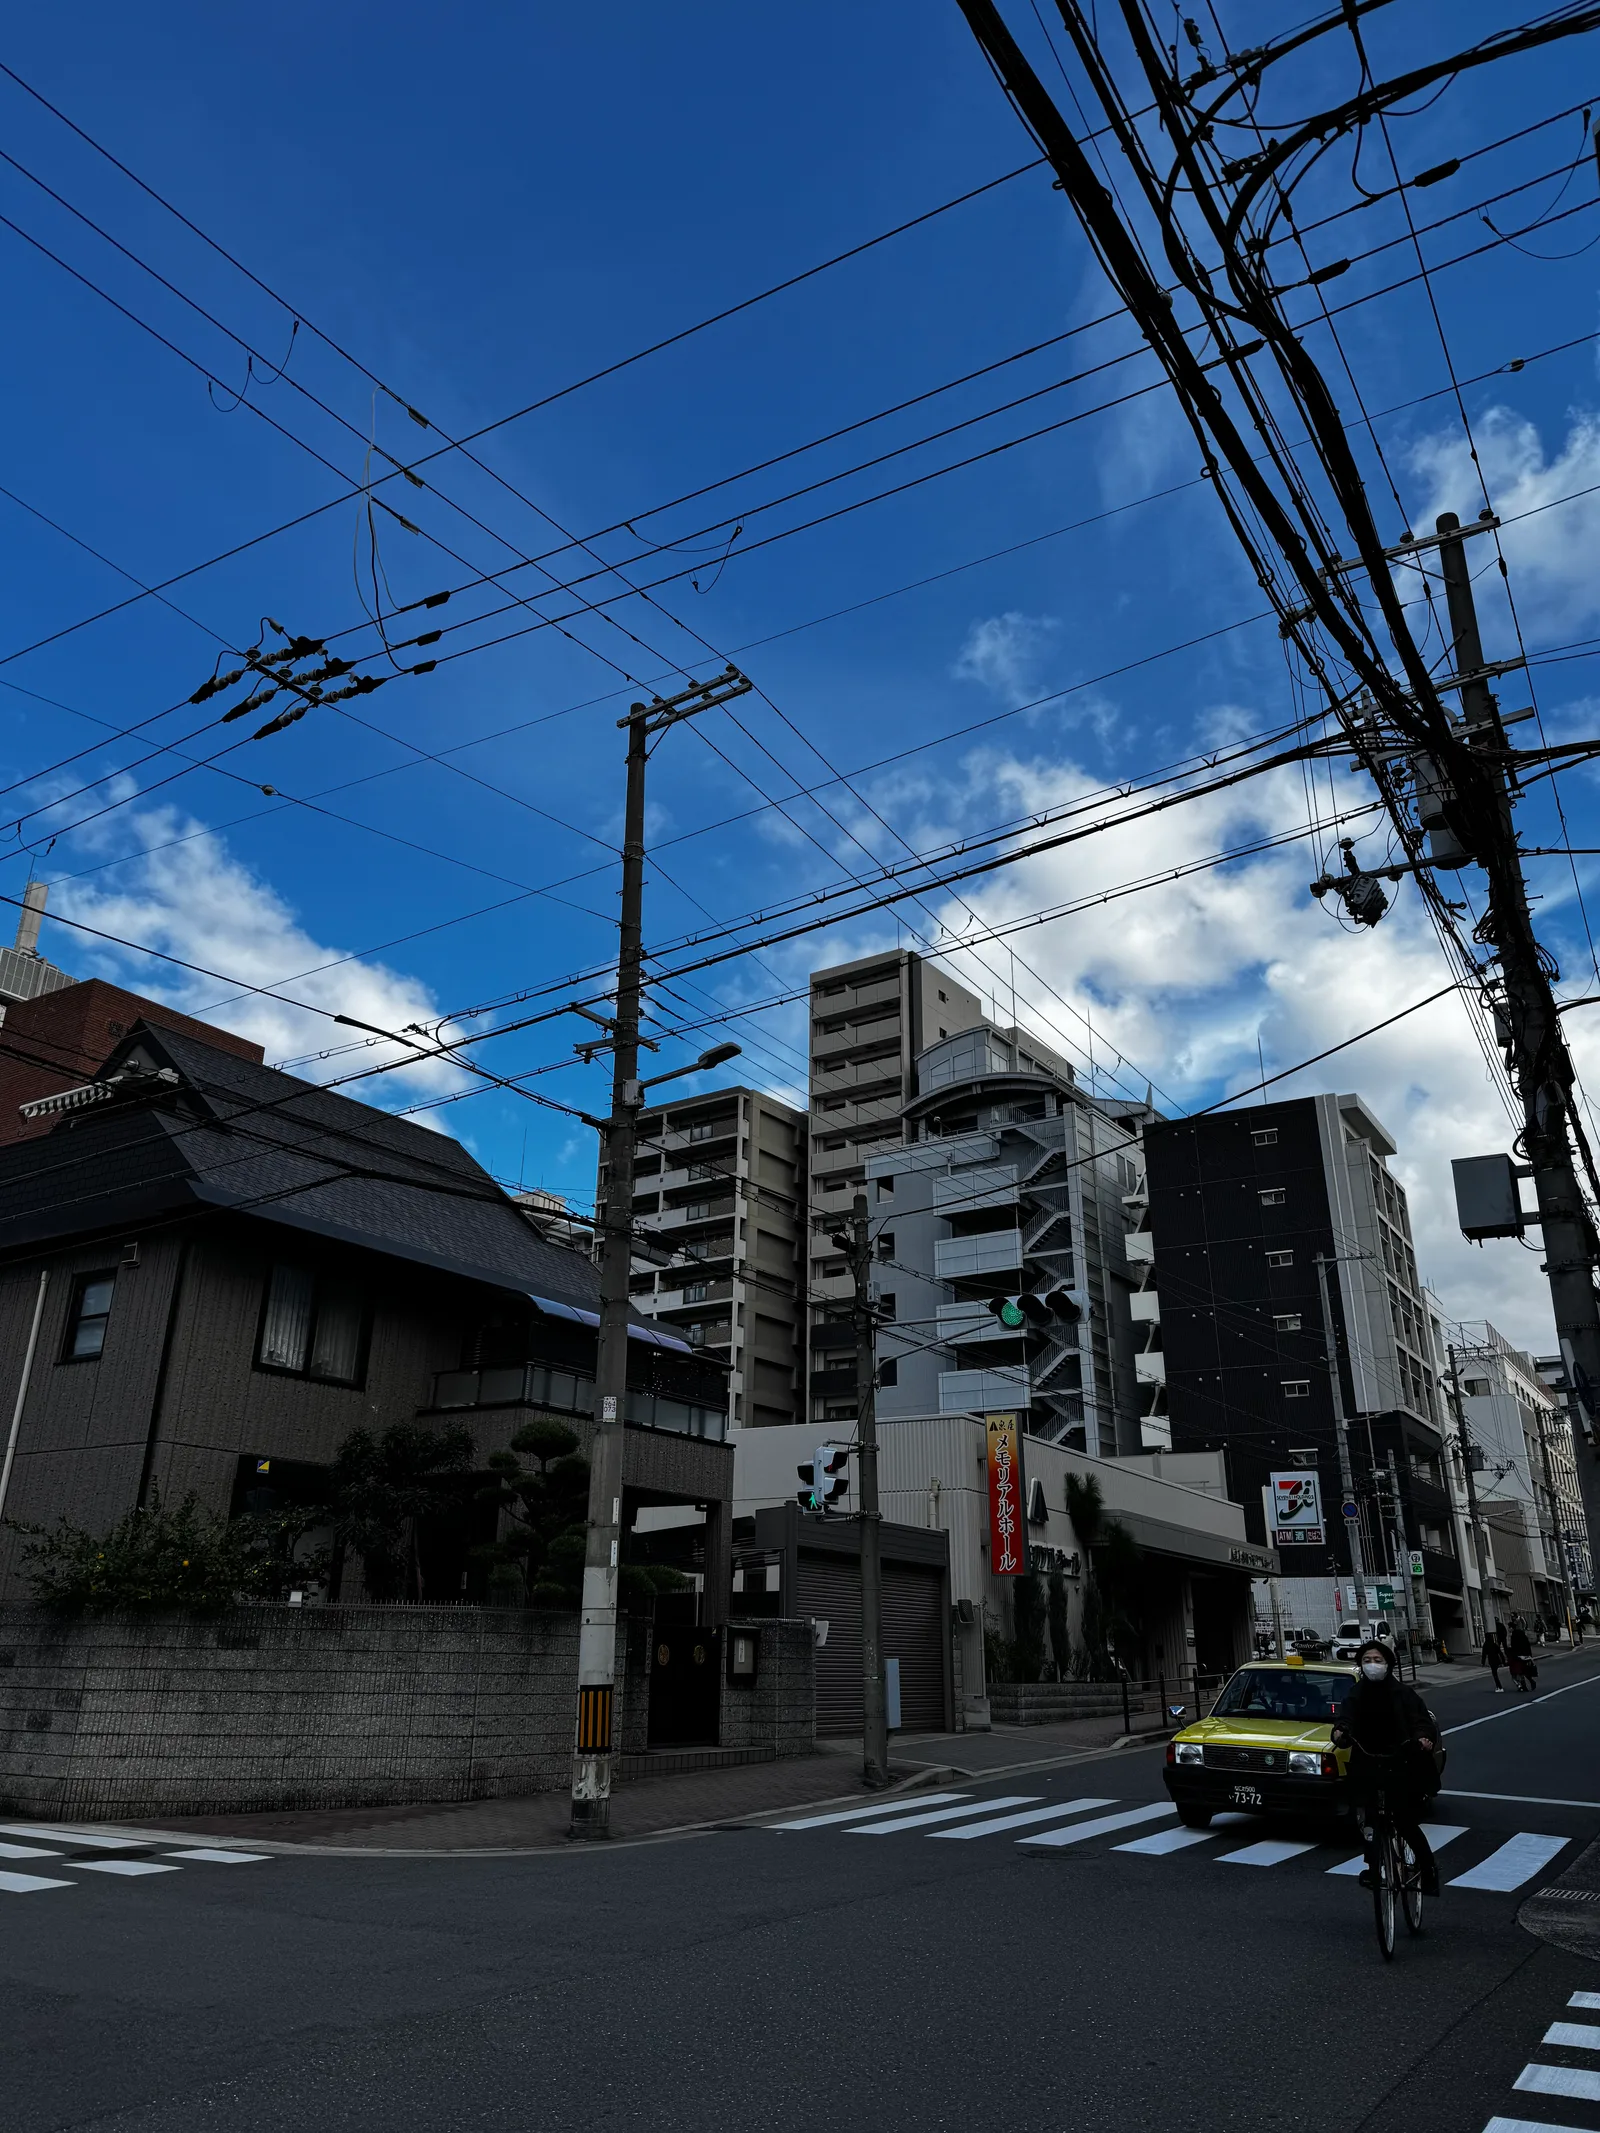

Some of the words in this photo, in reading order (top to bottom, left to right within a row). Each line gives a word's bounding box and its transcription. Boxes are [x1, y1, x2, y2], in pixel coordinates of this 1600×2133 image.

[995, 1434, 1016, 1571] メモリアルホール
[1279, 1531, 1292, 1541] ATM
[1235, 1792, 1262, 1804] 73-72
